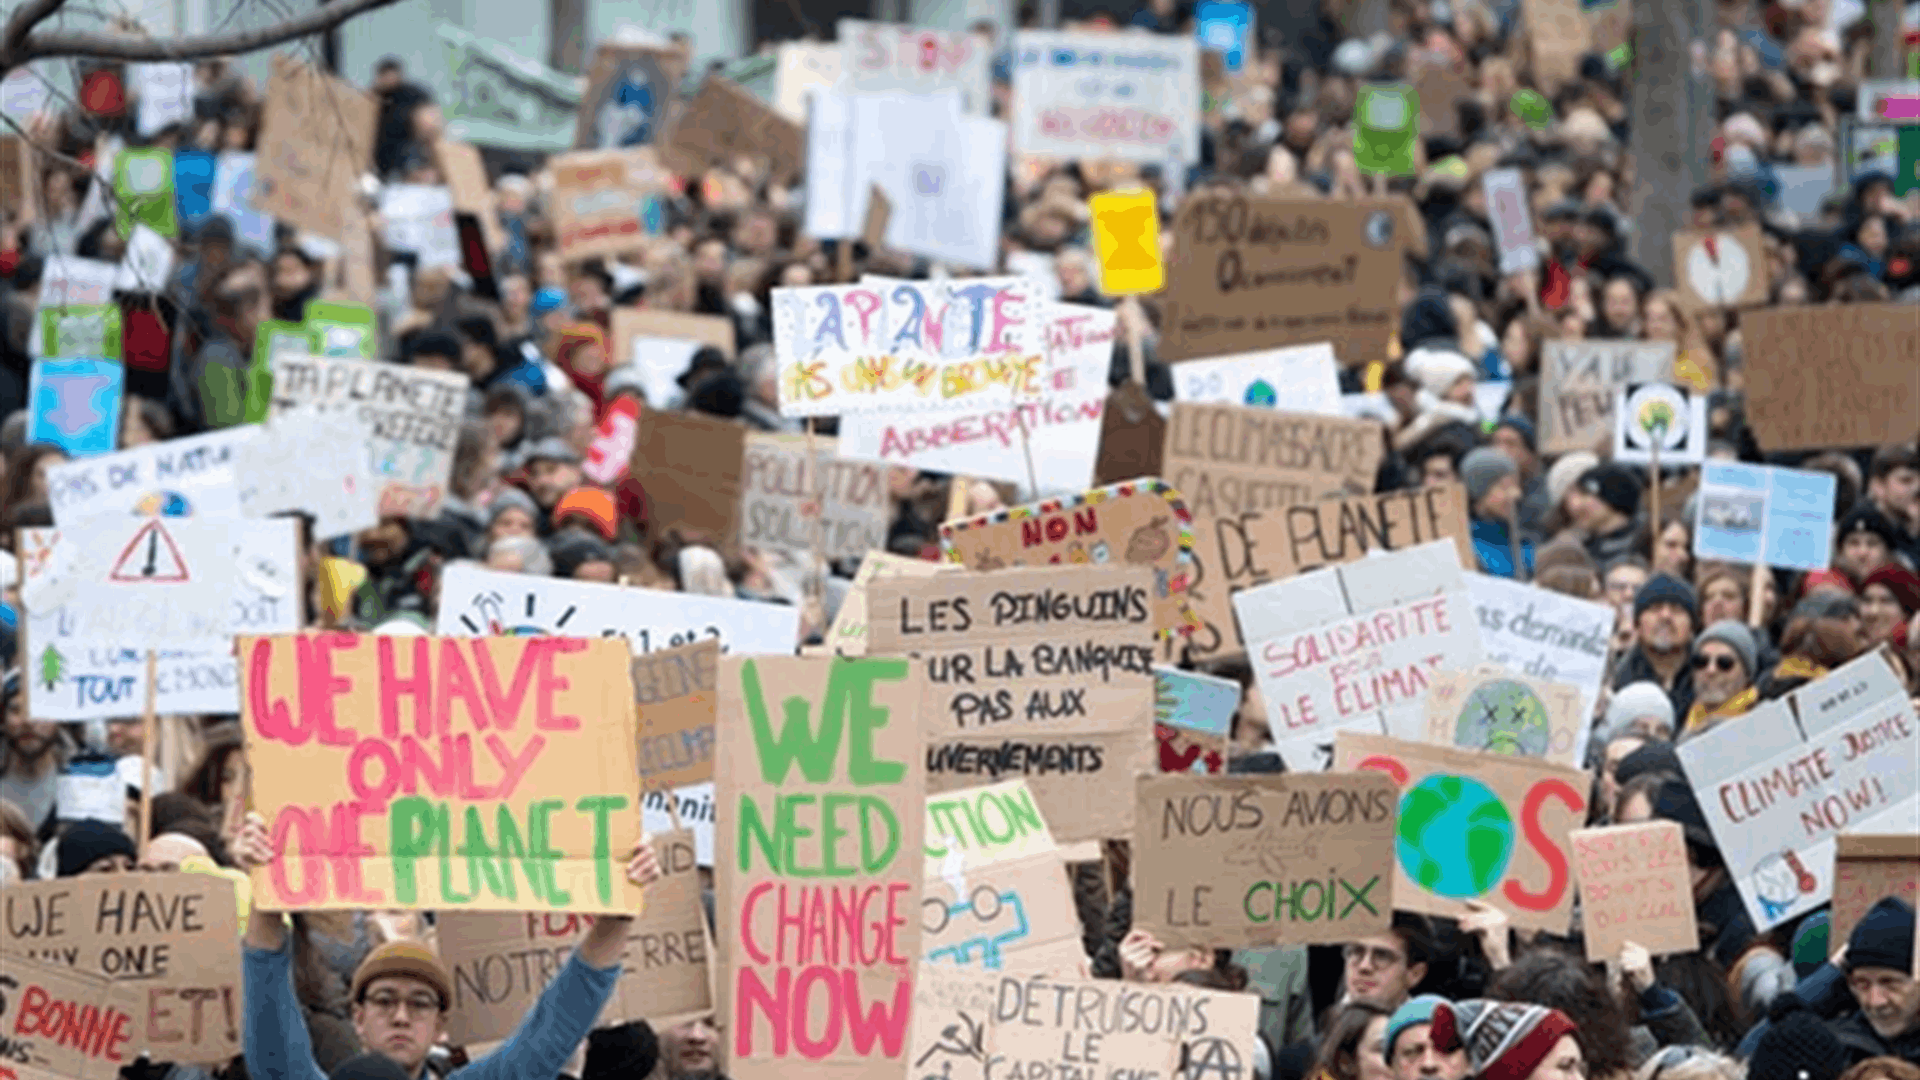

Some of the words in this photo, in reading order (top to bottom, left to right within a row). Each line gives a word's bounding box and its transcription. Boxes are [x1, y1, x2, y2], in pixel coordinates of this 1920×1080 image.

[1021, 506, 1099, 549] NON
[1215, 512, 1269, 581] DE
[901, 597, 972, 635] LES
[70, 673, 138, 711] TOUT
[248, 630, 360, 747] WE
[377, 635, 590, 741] HAVE
[909, 650, 976, 684] UR
[984, 647, 1023, 679] LA
[739, 657, 910, 788] WE
[950, 689, 1014, 728] PAS
[1025, 688, 1086, 721] AUX
[1280, 692, 1321, 730] LE
[346, 732, 546, 801] ONLY
[926, 740, 1104, 777] UVERNEMENTS
[1718, 746, 1836, 825] CLIMATE
[1161, 789, 1264, 840] NOUS
[1281, 787, 1391, 828] AVIONS
[1799, 775, 1888, 837] NOW!
[269, 800, 390, 908] ONE
[389, 794, 629, 908] PLANET
[736, 793, 903, 878] NEED
[6, 891, 71, 940] WE
[96, 888, 204, 936] HAVE
[738, 881, 912, 967] CHANGE
[1166, 885, 1214, 927] LE
[1243, 867, 1381, 925] CHOIX
[101, 944, 170, 976] ONE
[619, 929, 706, 975] ERRE
[15, 984, 132, 1062] BONNE
[734, 963, 913, 1061] NOW
[1062, 1031, 1104, 1065] LE
